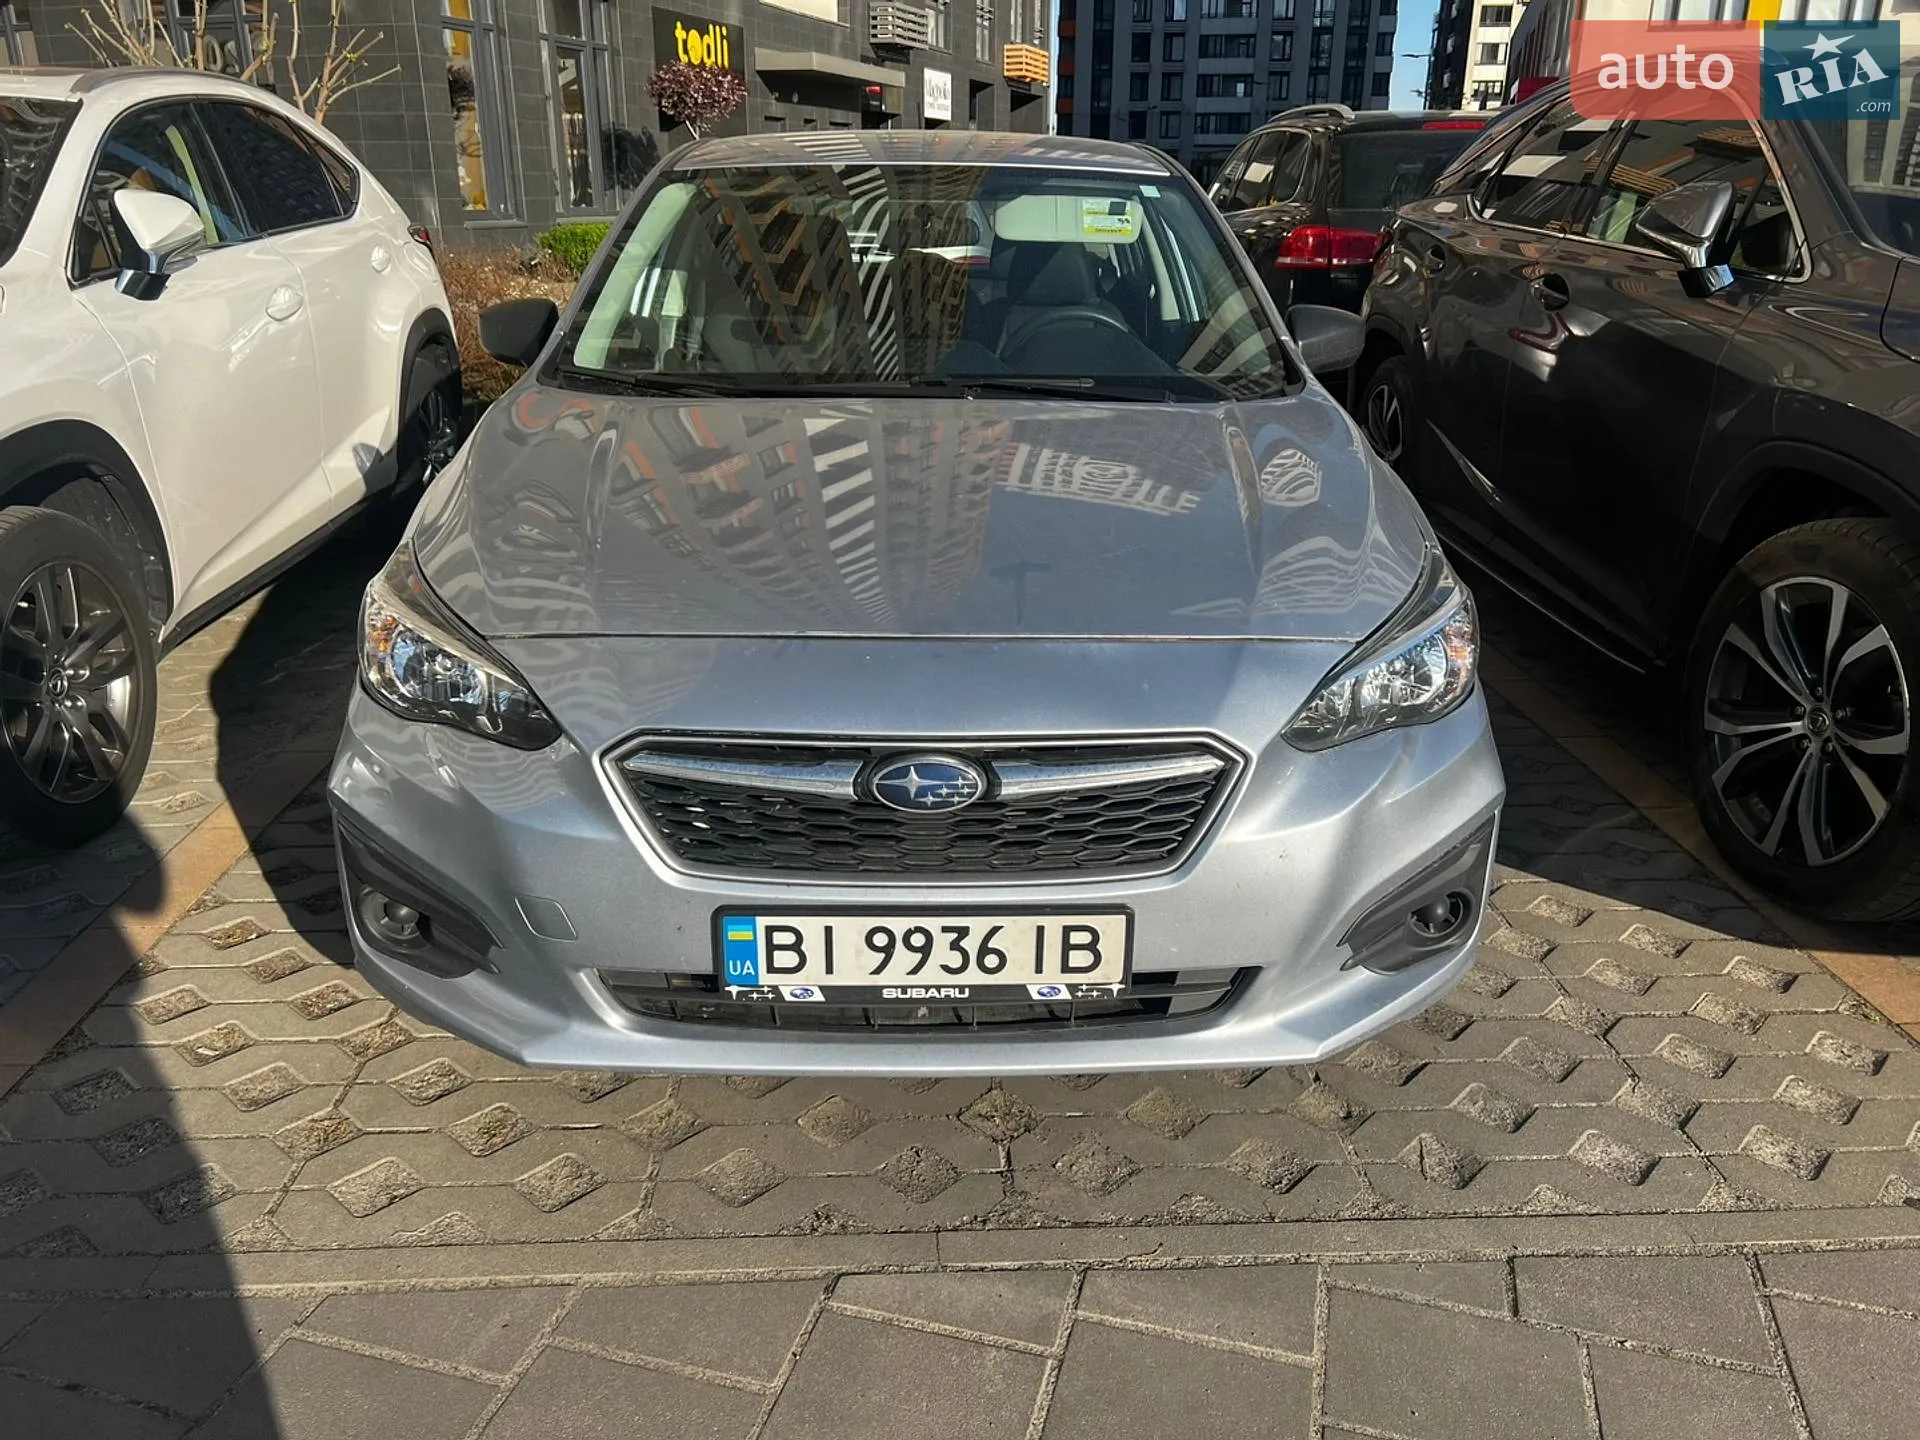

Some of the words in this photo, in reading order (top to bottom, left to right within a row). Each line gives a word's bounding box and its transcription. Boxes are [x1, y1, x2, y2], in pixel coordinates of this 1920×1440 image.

[674, 21, 729, 70] todli
[764, 925, 834, 975] BI
[864, 925, 1006, 975] 9936
[1034, 925, 1102, 974] IB
[728, 960, 755, 976] UA
[882, 988, 970, 999] SUBARU
